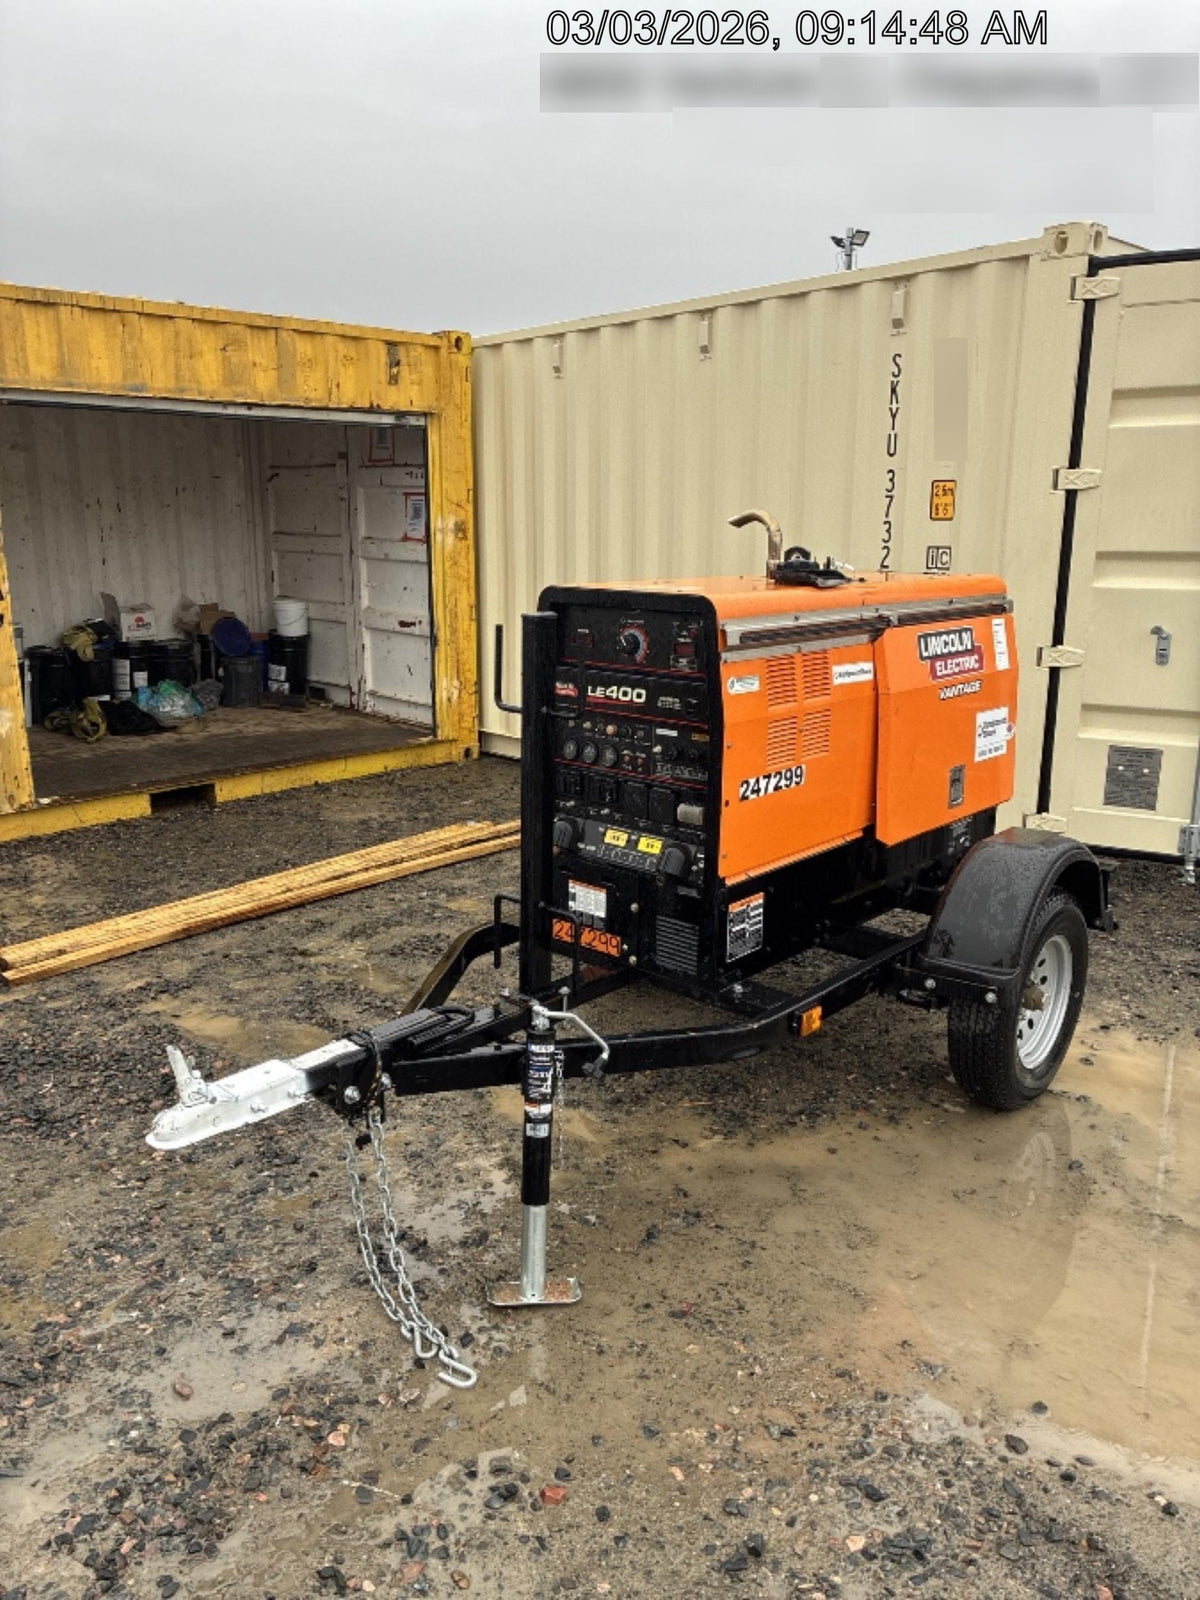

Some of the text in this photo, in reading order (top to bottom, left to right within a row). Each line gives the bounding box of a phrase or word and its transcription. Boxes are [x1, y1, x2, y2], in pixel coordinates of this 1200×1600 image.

[886, 353, 902, 458] SKYU
[920, 629, 972, 657] LINCOLN
[935, 654, 979, 677] ELECTRIC
[587, 685, 646, 703] LE400
[939, 679, 982, 700] VANTAGE
[740, 765, 804, 800] 247299
